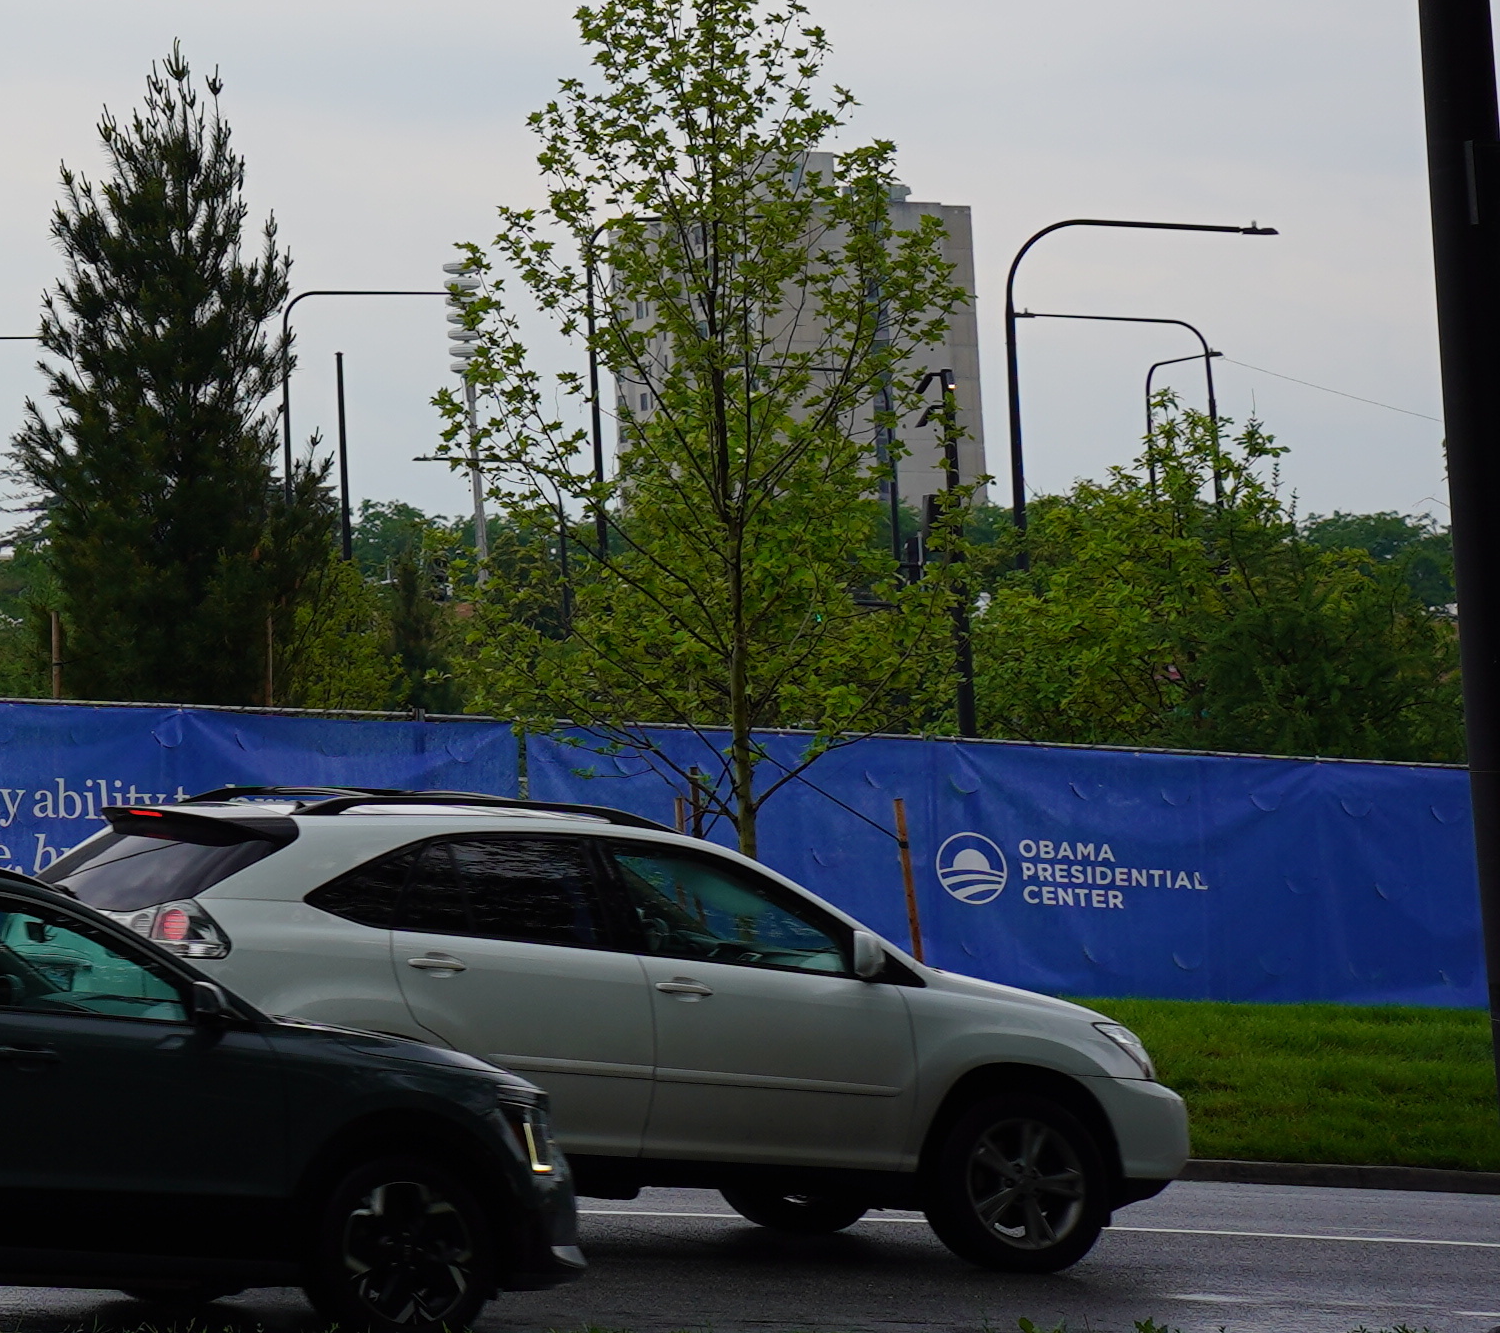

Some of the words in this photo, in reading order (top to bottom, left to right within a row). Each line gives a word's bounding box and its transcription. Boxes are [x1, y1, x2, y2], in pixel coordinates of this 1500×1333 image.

[1018, 839, 1116, 863] OBAMA
[1021, 862, 1209, 891] PRESIDENTIAL
[1022, 885, 1125, 909] CENTER
